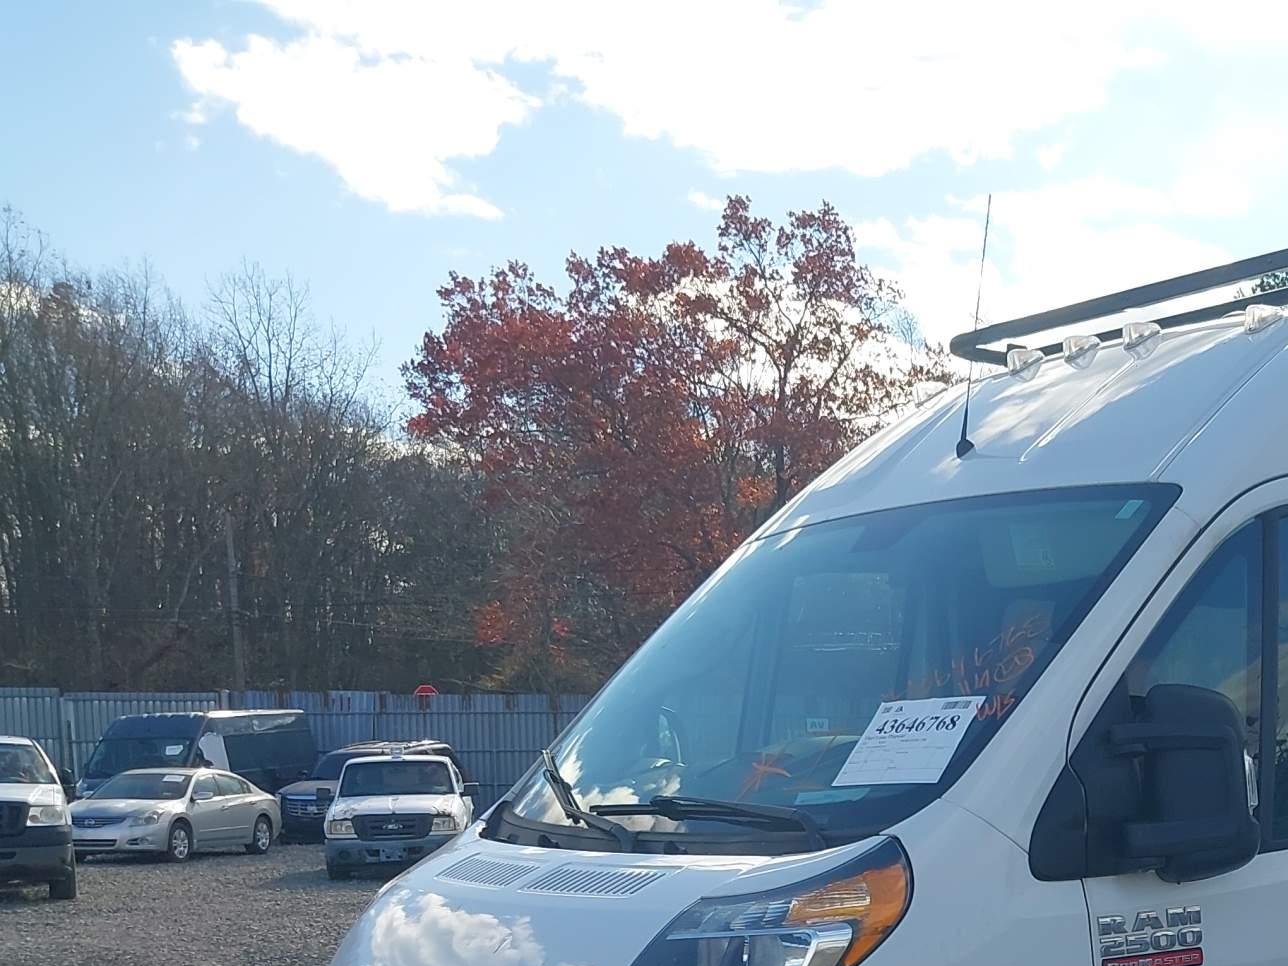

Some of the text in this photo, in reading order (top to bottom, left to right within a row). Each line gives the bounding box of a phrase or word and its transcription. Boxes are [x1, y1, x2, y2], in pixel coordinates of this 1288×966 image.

[875, 714, 961, 735] 43646768
[1097, 905, 1201, 936] RAM
[1100, 926, 1202, 957] 2500
